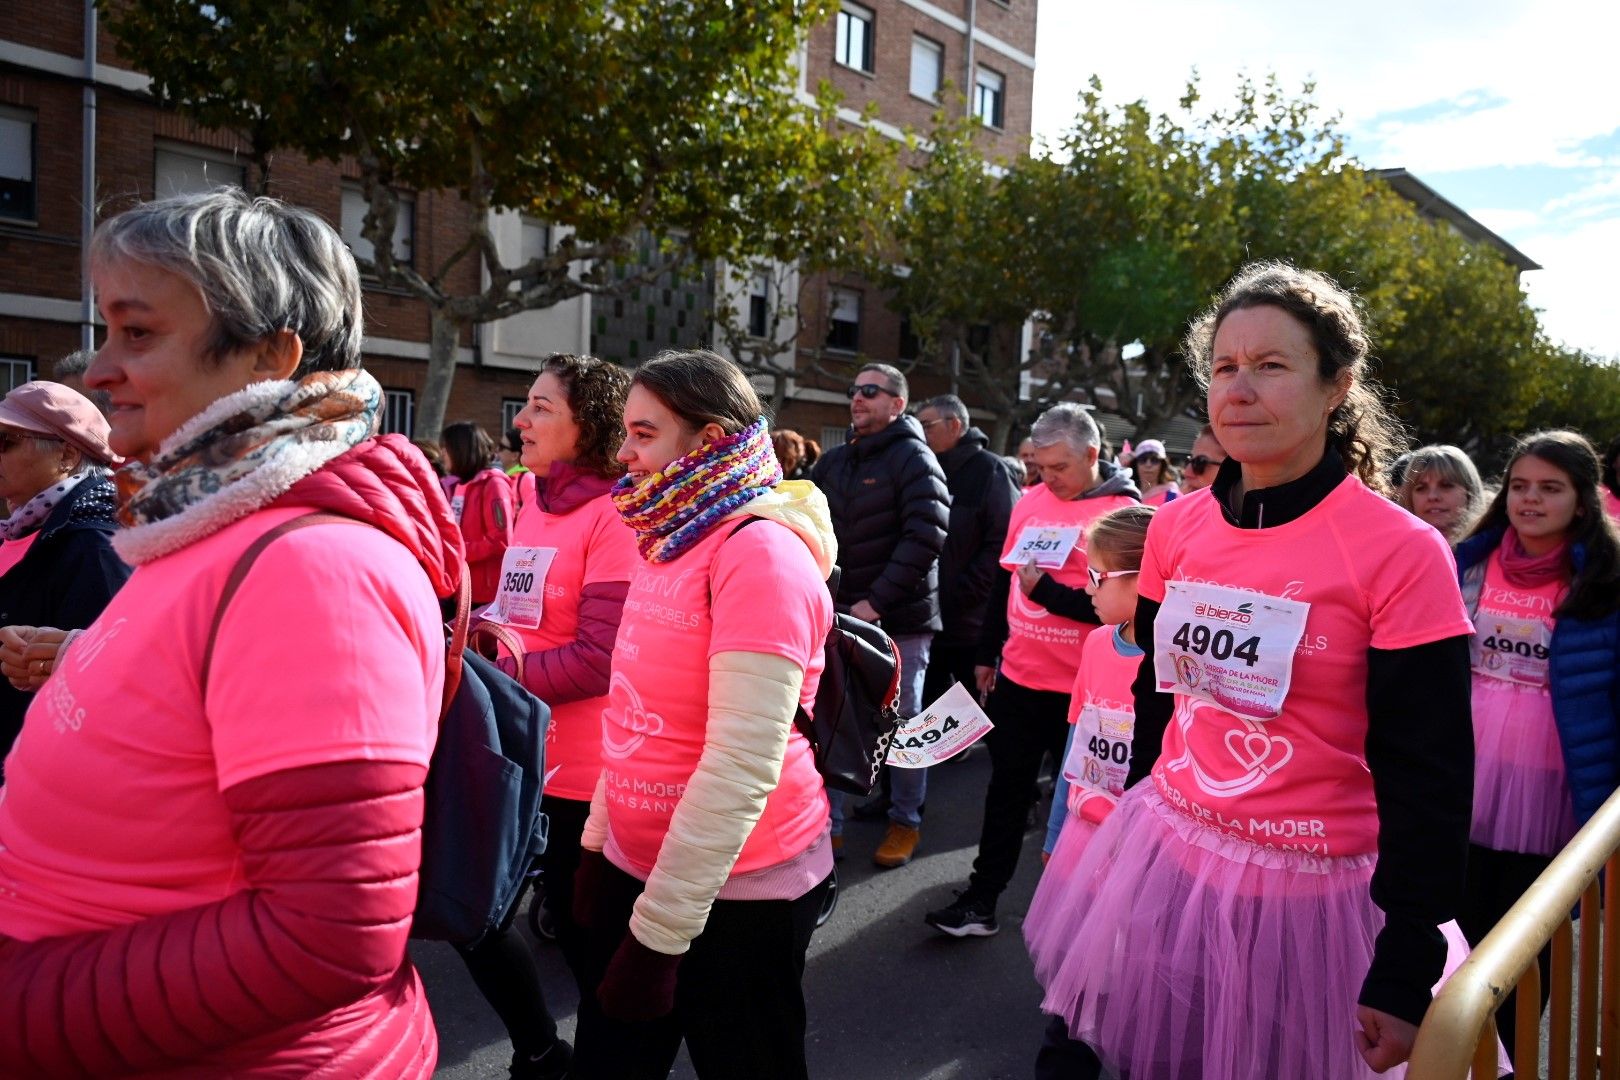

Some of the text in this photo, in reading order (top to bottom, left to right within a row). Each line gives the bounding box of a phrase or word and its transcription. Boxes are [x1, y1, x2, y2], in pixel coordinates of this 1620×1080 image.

[1023, 540, 1061, 551] 3501
[503, 571, 534, 594] 3500
[1195, 604, 1251, 623] el bierzo
[1172, 622, 1261, 667] 4904
[1483, 635, 1550, 660] 4909
[1229, 669, 1238, 677] DE
[1240, 672, 1250, 680] LA
[1251, 674, 1279, 687] MUJER
[1088, 735, 1128, 764] 490
[615, 773, 631, 789] LA
[1191, 802, 1214, 821] DE
[1216, 812, 1244, 831] LA
[1249, 817, 1326, 838] MUJER
